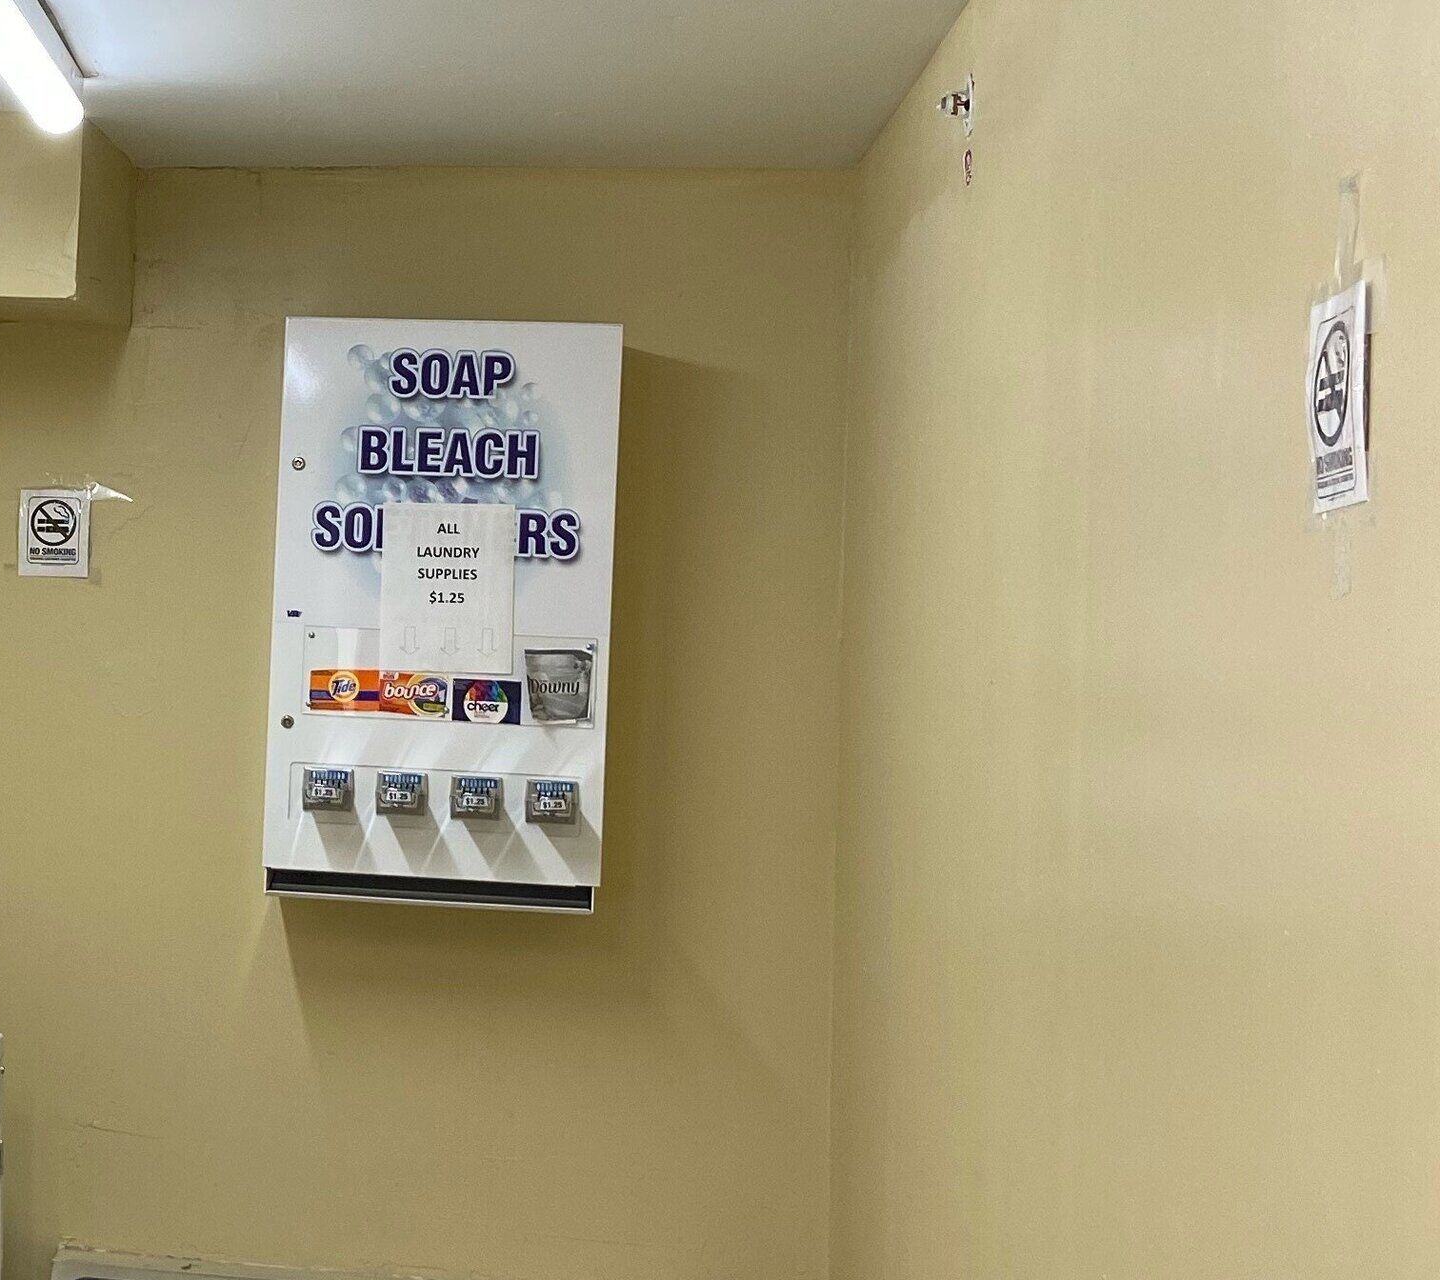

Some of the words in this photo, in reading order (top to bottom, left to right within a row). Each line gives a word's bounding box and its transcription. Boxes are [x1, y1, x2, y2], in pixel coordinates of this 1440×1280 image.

[389, 351, 514, 398] SOAP
[358, 428, 540, 478] BLEACH
[437, 523, 460, 534] ALL
[29, 547, 41, 555] NO
[41, 547, 76, 556] SMOKING
[417, 546, 480, 559] LAUNDRY
[417, 568, 478, 580] SUPPLIES
[429, 590, 465, 604] $1.25
[330, 678, 357, 696] Tide
[384, 682, 439, 700] bounce
[530, 678, 580, 696] Downy
[467, 701, 500, 713] cheer
